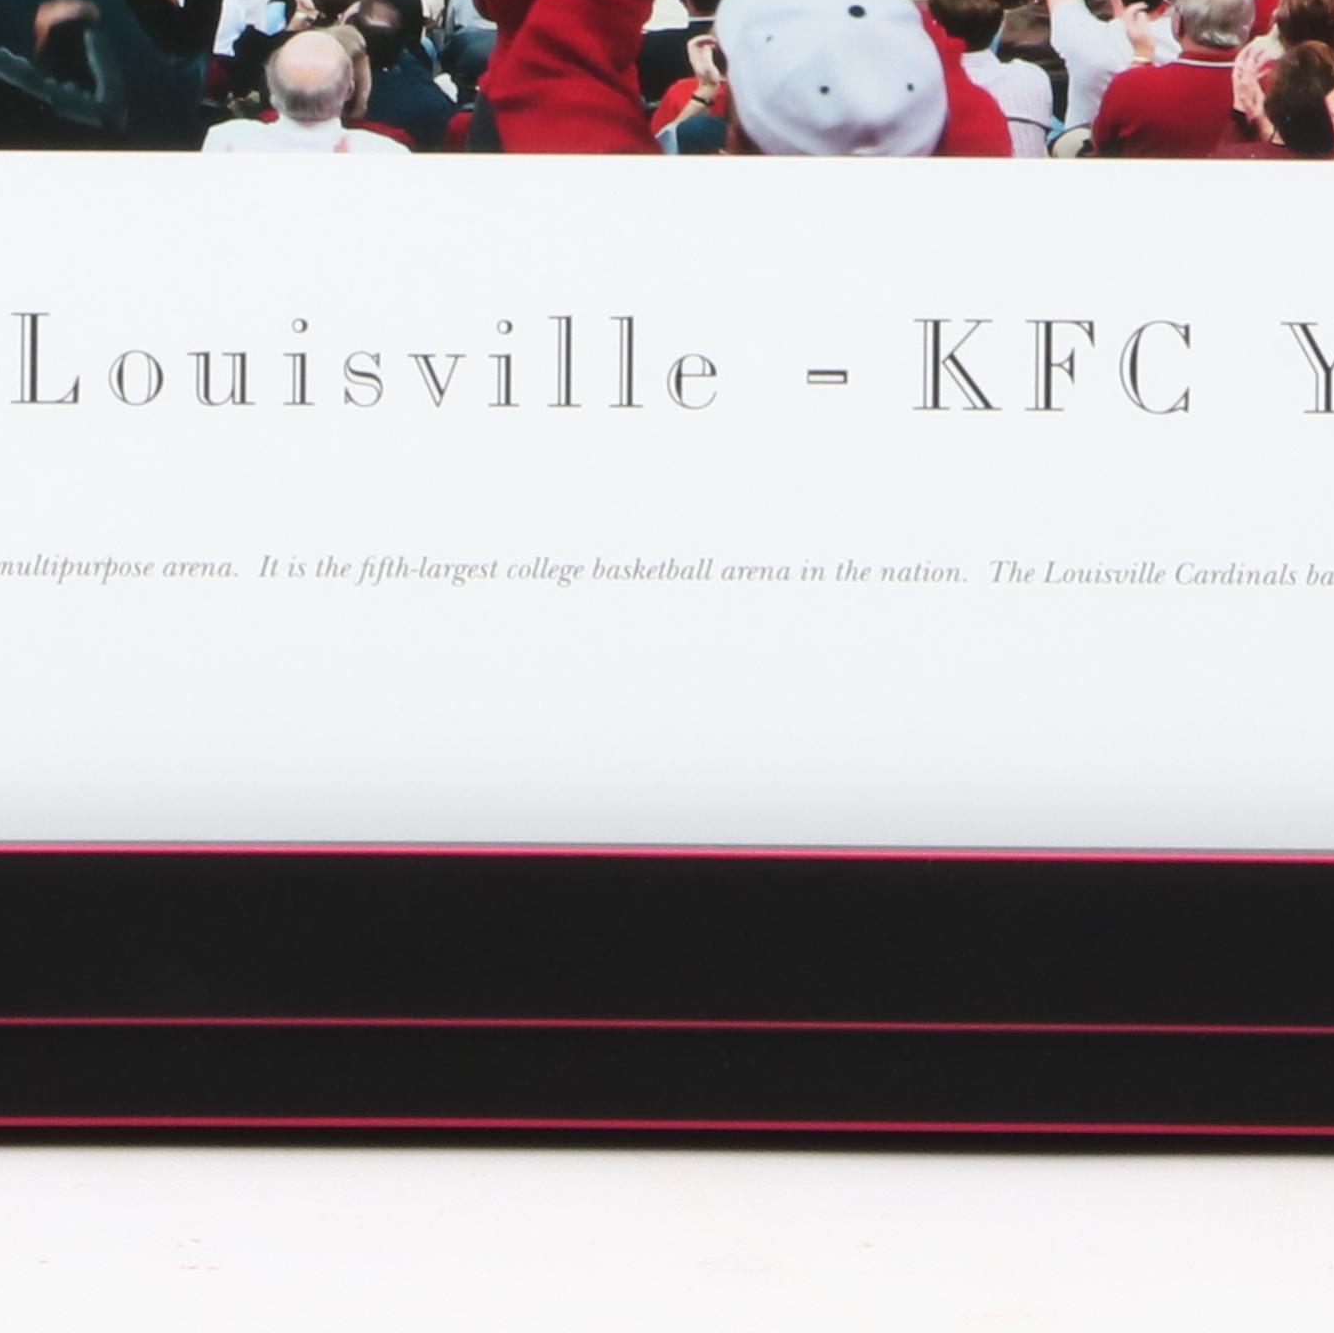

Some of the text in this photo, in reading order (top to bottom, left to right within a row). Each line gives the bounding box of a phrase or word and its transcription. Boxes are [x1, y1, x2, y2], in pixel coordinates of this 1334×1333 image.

[12, 313, 716, 409] Louisville
[915, 319, 1190, 413] KFC
[162, 562, 238, 577] arena.
[259, 555, 278, 577] It
[288, 556, 305, 577] is
[316, 555, 351, 577] the
[355, 556, 497, 586] fifth-largest
[507, 557, 584, 587] college
[592, 557, 713, 580] basketball
[721, 566, 790, 581] arena
[801, 559, 824, 581] in
[836, 559, 871, 581] the
[881, 561, 967, 582] nation.
[991, 561, 1035, 583] The
[1044, 561, 1166, 584] Louisville
[1175, 562, 1296, 585] Cardinals
